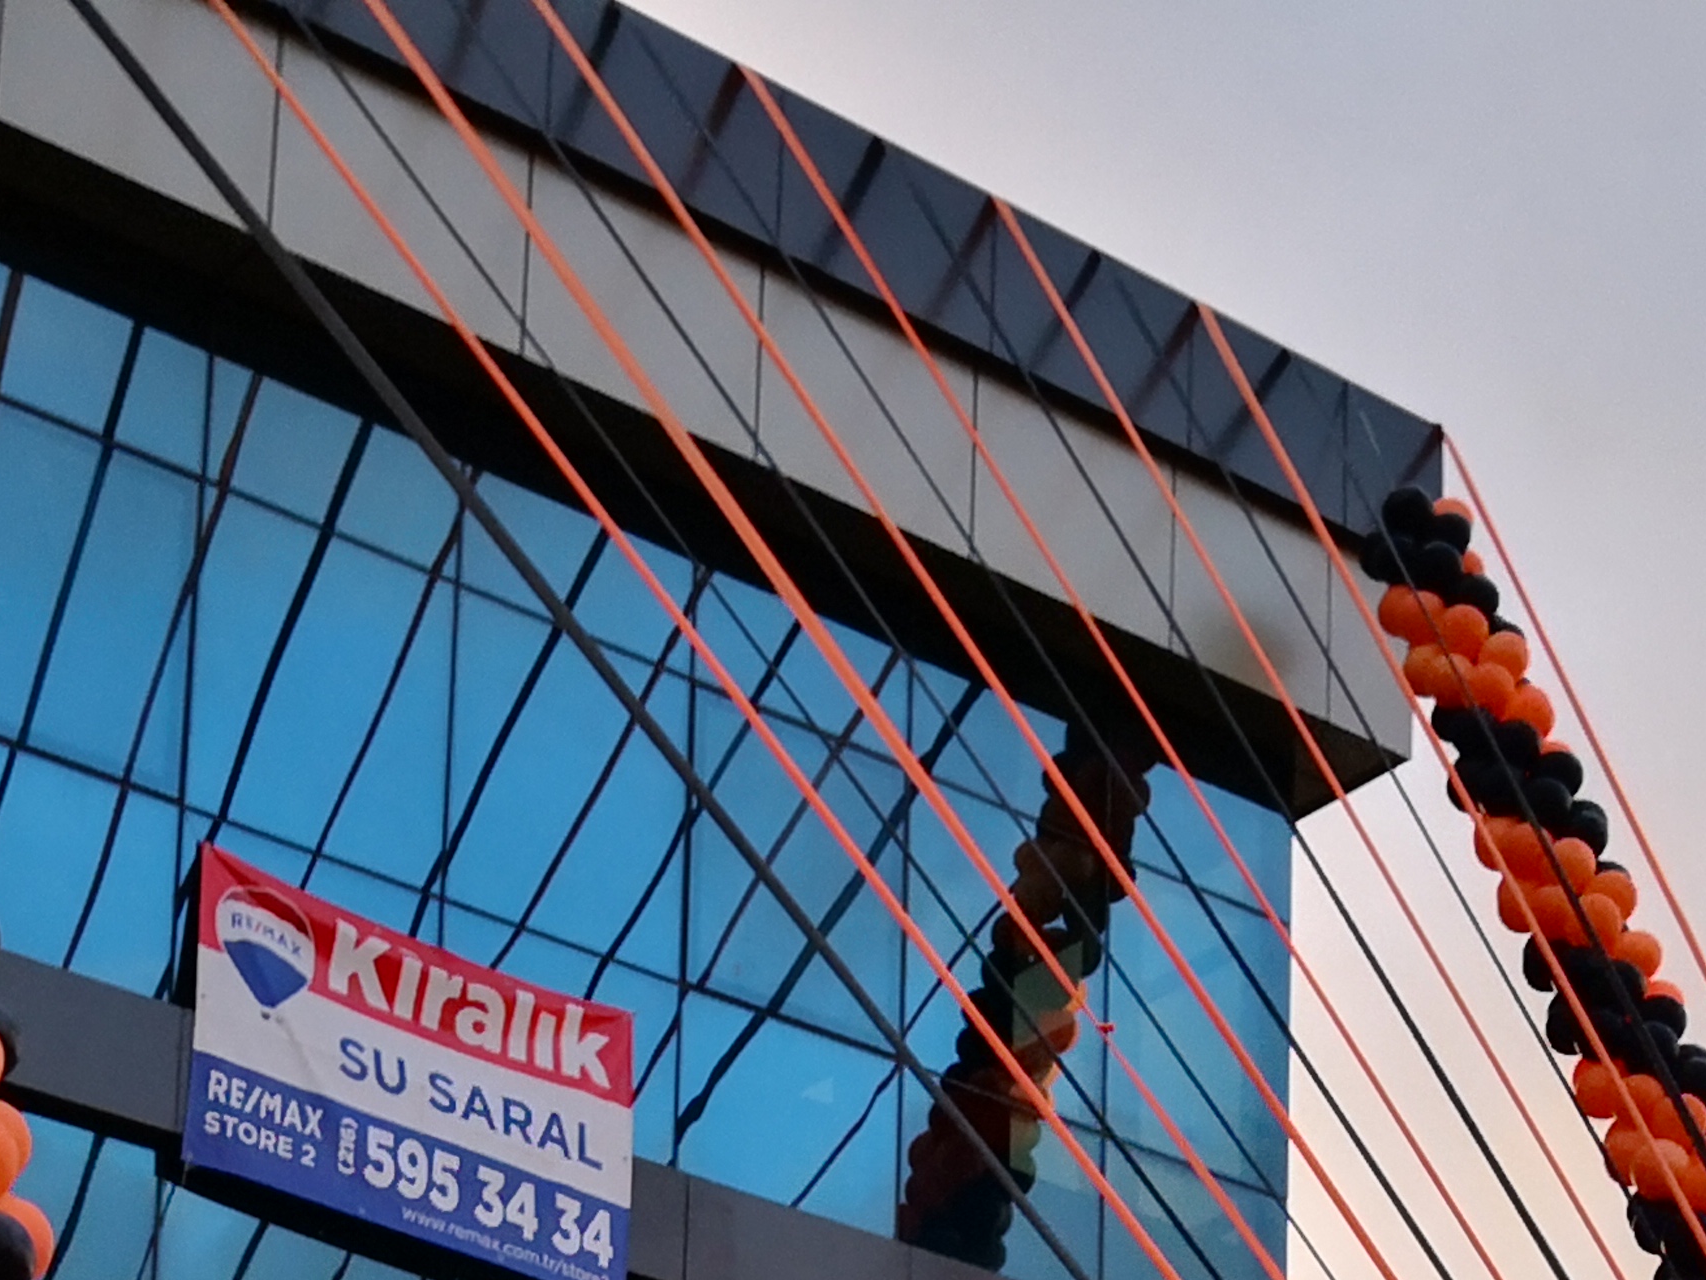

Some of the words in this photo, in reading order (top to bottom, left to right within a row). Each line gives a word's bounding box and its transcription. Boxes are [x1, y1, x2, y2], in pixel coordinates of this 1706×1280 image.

[203, 1110, 294, 1160] STORE
[299, 1143, 317, 1168] 2
[207, 1069, 324, 1141] RE/MAX
[338, 1036, 408, 1096] SU
[427, 1071, 604, 1172] SARAL
[363, 1125, 461, 1212] 595
[473, 1163, 539, 1242] 34
[551, 1191, 614, 1269] 34
